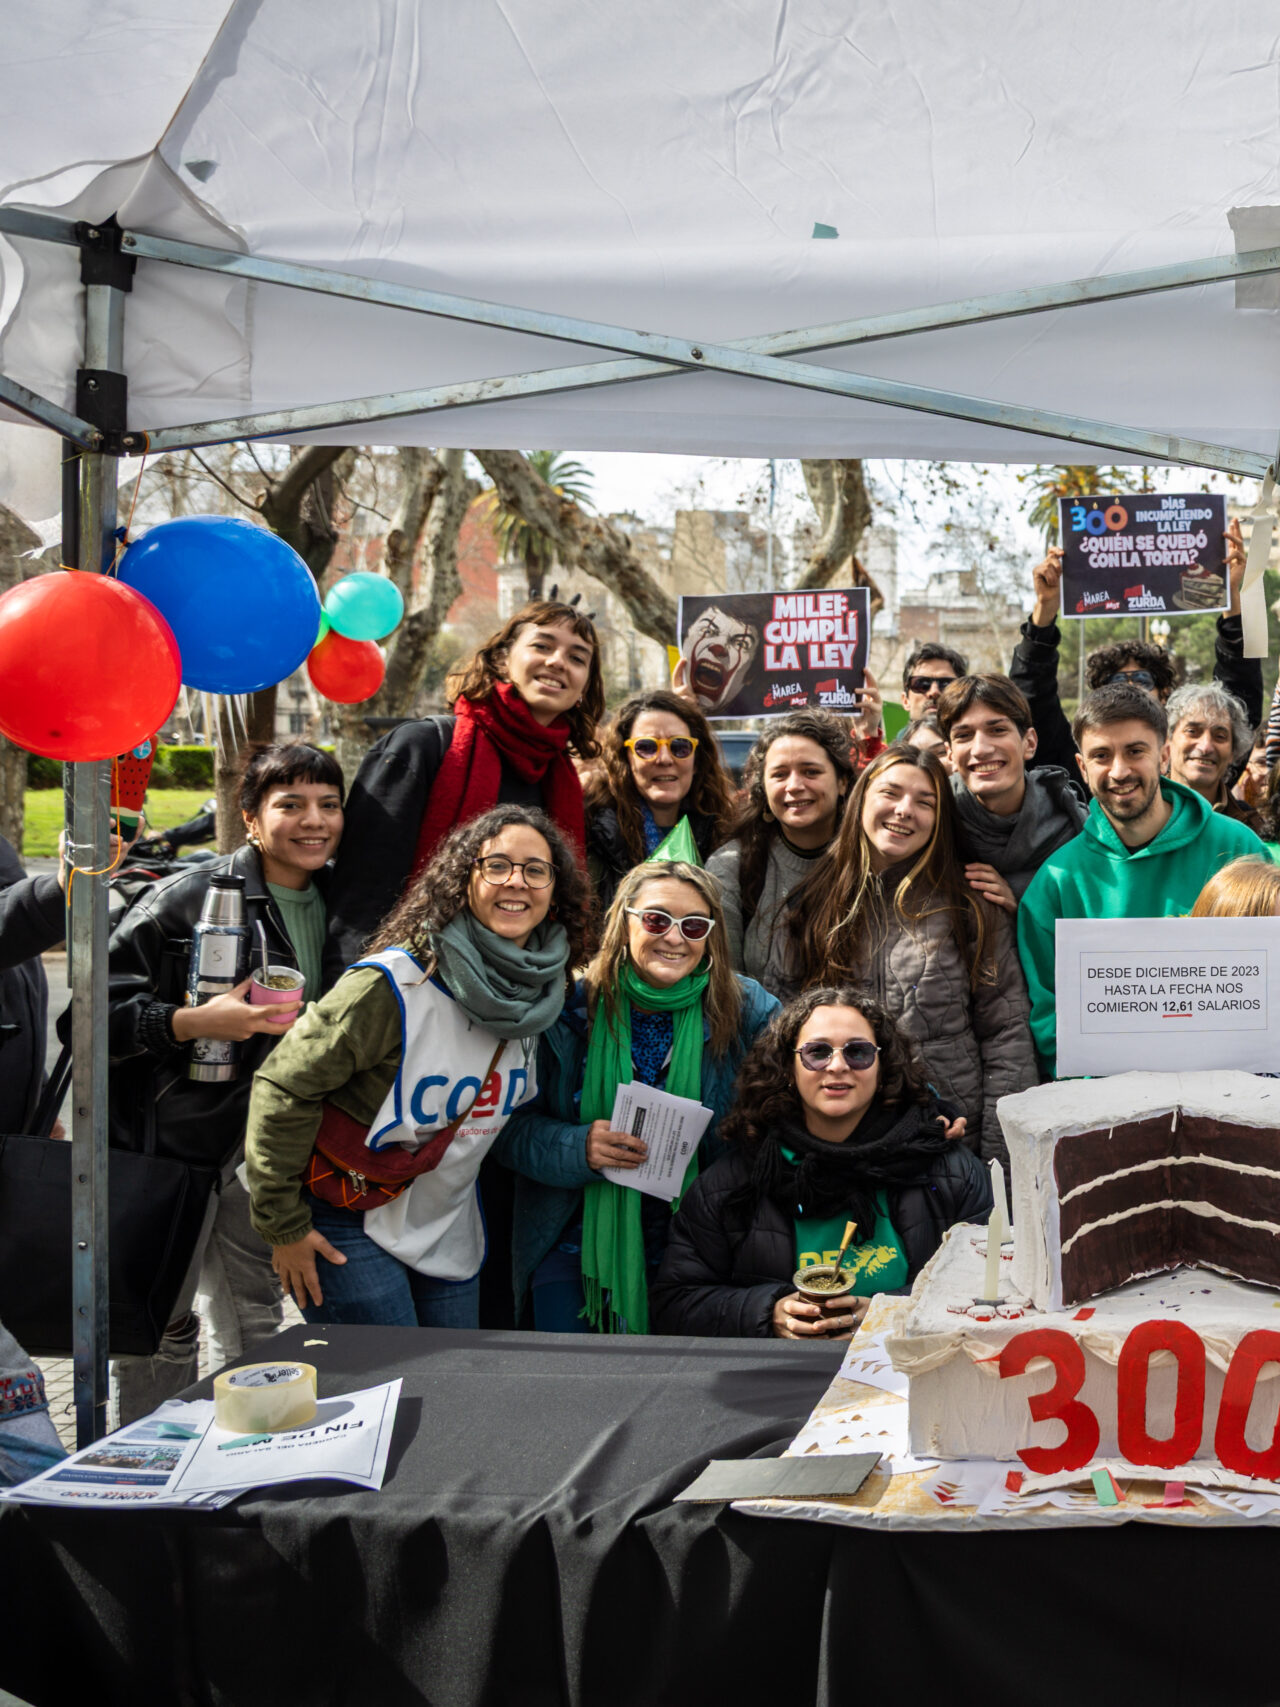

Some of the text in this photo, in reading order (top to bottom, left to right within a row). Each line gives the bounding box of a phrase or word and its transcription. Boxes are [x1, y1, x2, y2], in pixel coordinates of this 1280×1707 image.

[1161, 496, 1186, 510] DÍAS
[1070, 504, 1128, 535] 300
[1136, 508, 1212, 522] INCUMPLIENDO
[1157, 521, 1192, 532] LA LEY
[1079, 530, 1208, 553] ¿QUIÉN SE QUEDÓ
[1088, 549, 1199, 568] CON LA TORTA?
[1128, 596, 1166, 610] ZURDA
[764, 610, 858, 644] CUMPLÍ
[764, 642, 858, 671] LA LEY
[772, 683, 802, 700] MAREA
[819, 692, 856, 705] ZURDA
[1087, 965, 1260, 979] DESDE DICIEMBRE DE 2023
[1104, 982, 1244, 996] HASTA LA FECHA NOS
[1087, 999, 1261, 1013] COMIERON 12,61 SALARIOS
[325, 1420, 364, 1435] FIN
